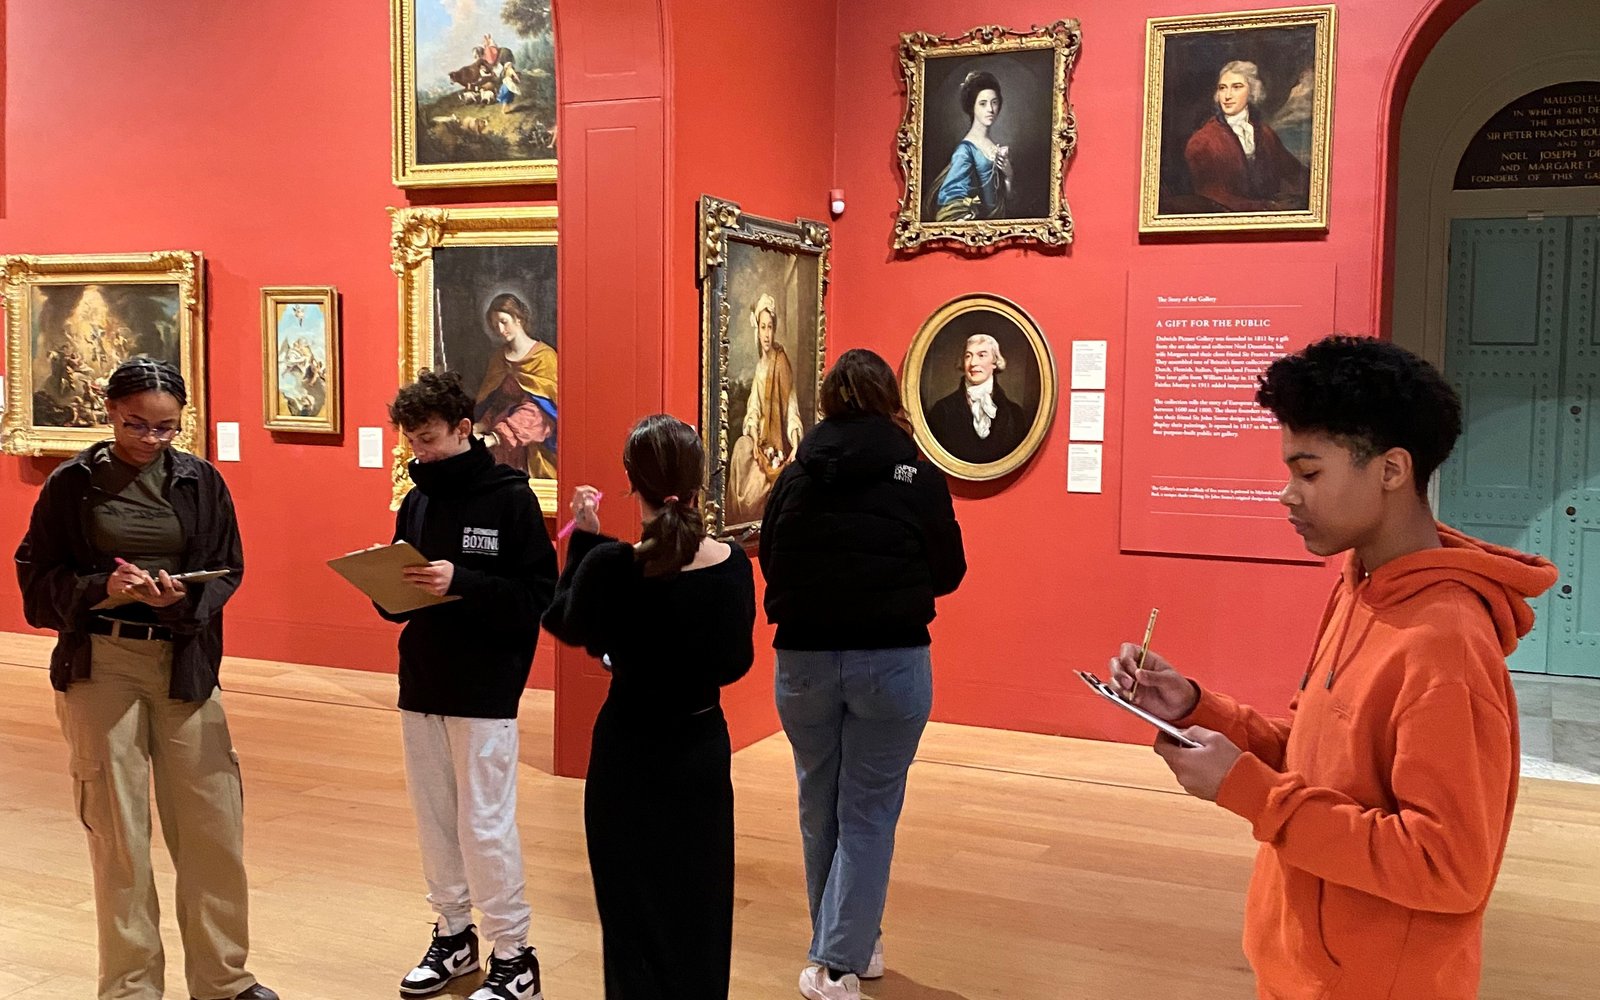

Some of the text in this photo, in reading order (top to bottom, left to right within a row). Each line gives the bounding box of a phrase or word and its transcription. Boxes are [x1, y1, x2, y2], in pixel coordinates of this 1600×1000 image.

[1543, 95, 1600, 105] MAUSOLEU
[1529, 108, 1561, 116] WHICH
[1566, 107, 1582, 115] ARE
[1532, 117, 1596, 127] THE REMAINS
[1487, 132, 1500, 140] SIR
[1503, 131, 1532, 140] PETER
[1535, 129, 1578, 138] FRANCIS
[1557, 139, 1596, 148] AND OF
[1501, 150, 1577, 161] NOEL JOSEPH
[1500, 161, 1592, 173] AND MARGARET
[1471, 175, 1519, 183] FOUNDERS
[1552, 173, 1573, 181] THIS
[1168, 296, 1181, 304] Story
[1156, 320, 1162, 328] A
[1165, 320, 1187, 328] GIFT
[1190, 320, 1210, 328] FOR
[1235, 319, 1271, 327] PUBLIC
